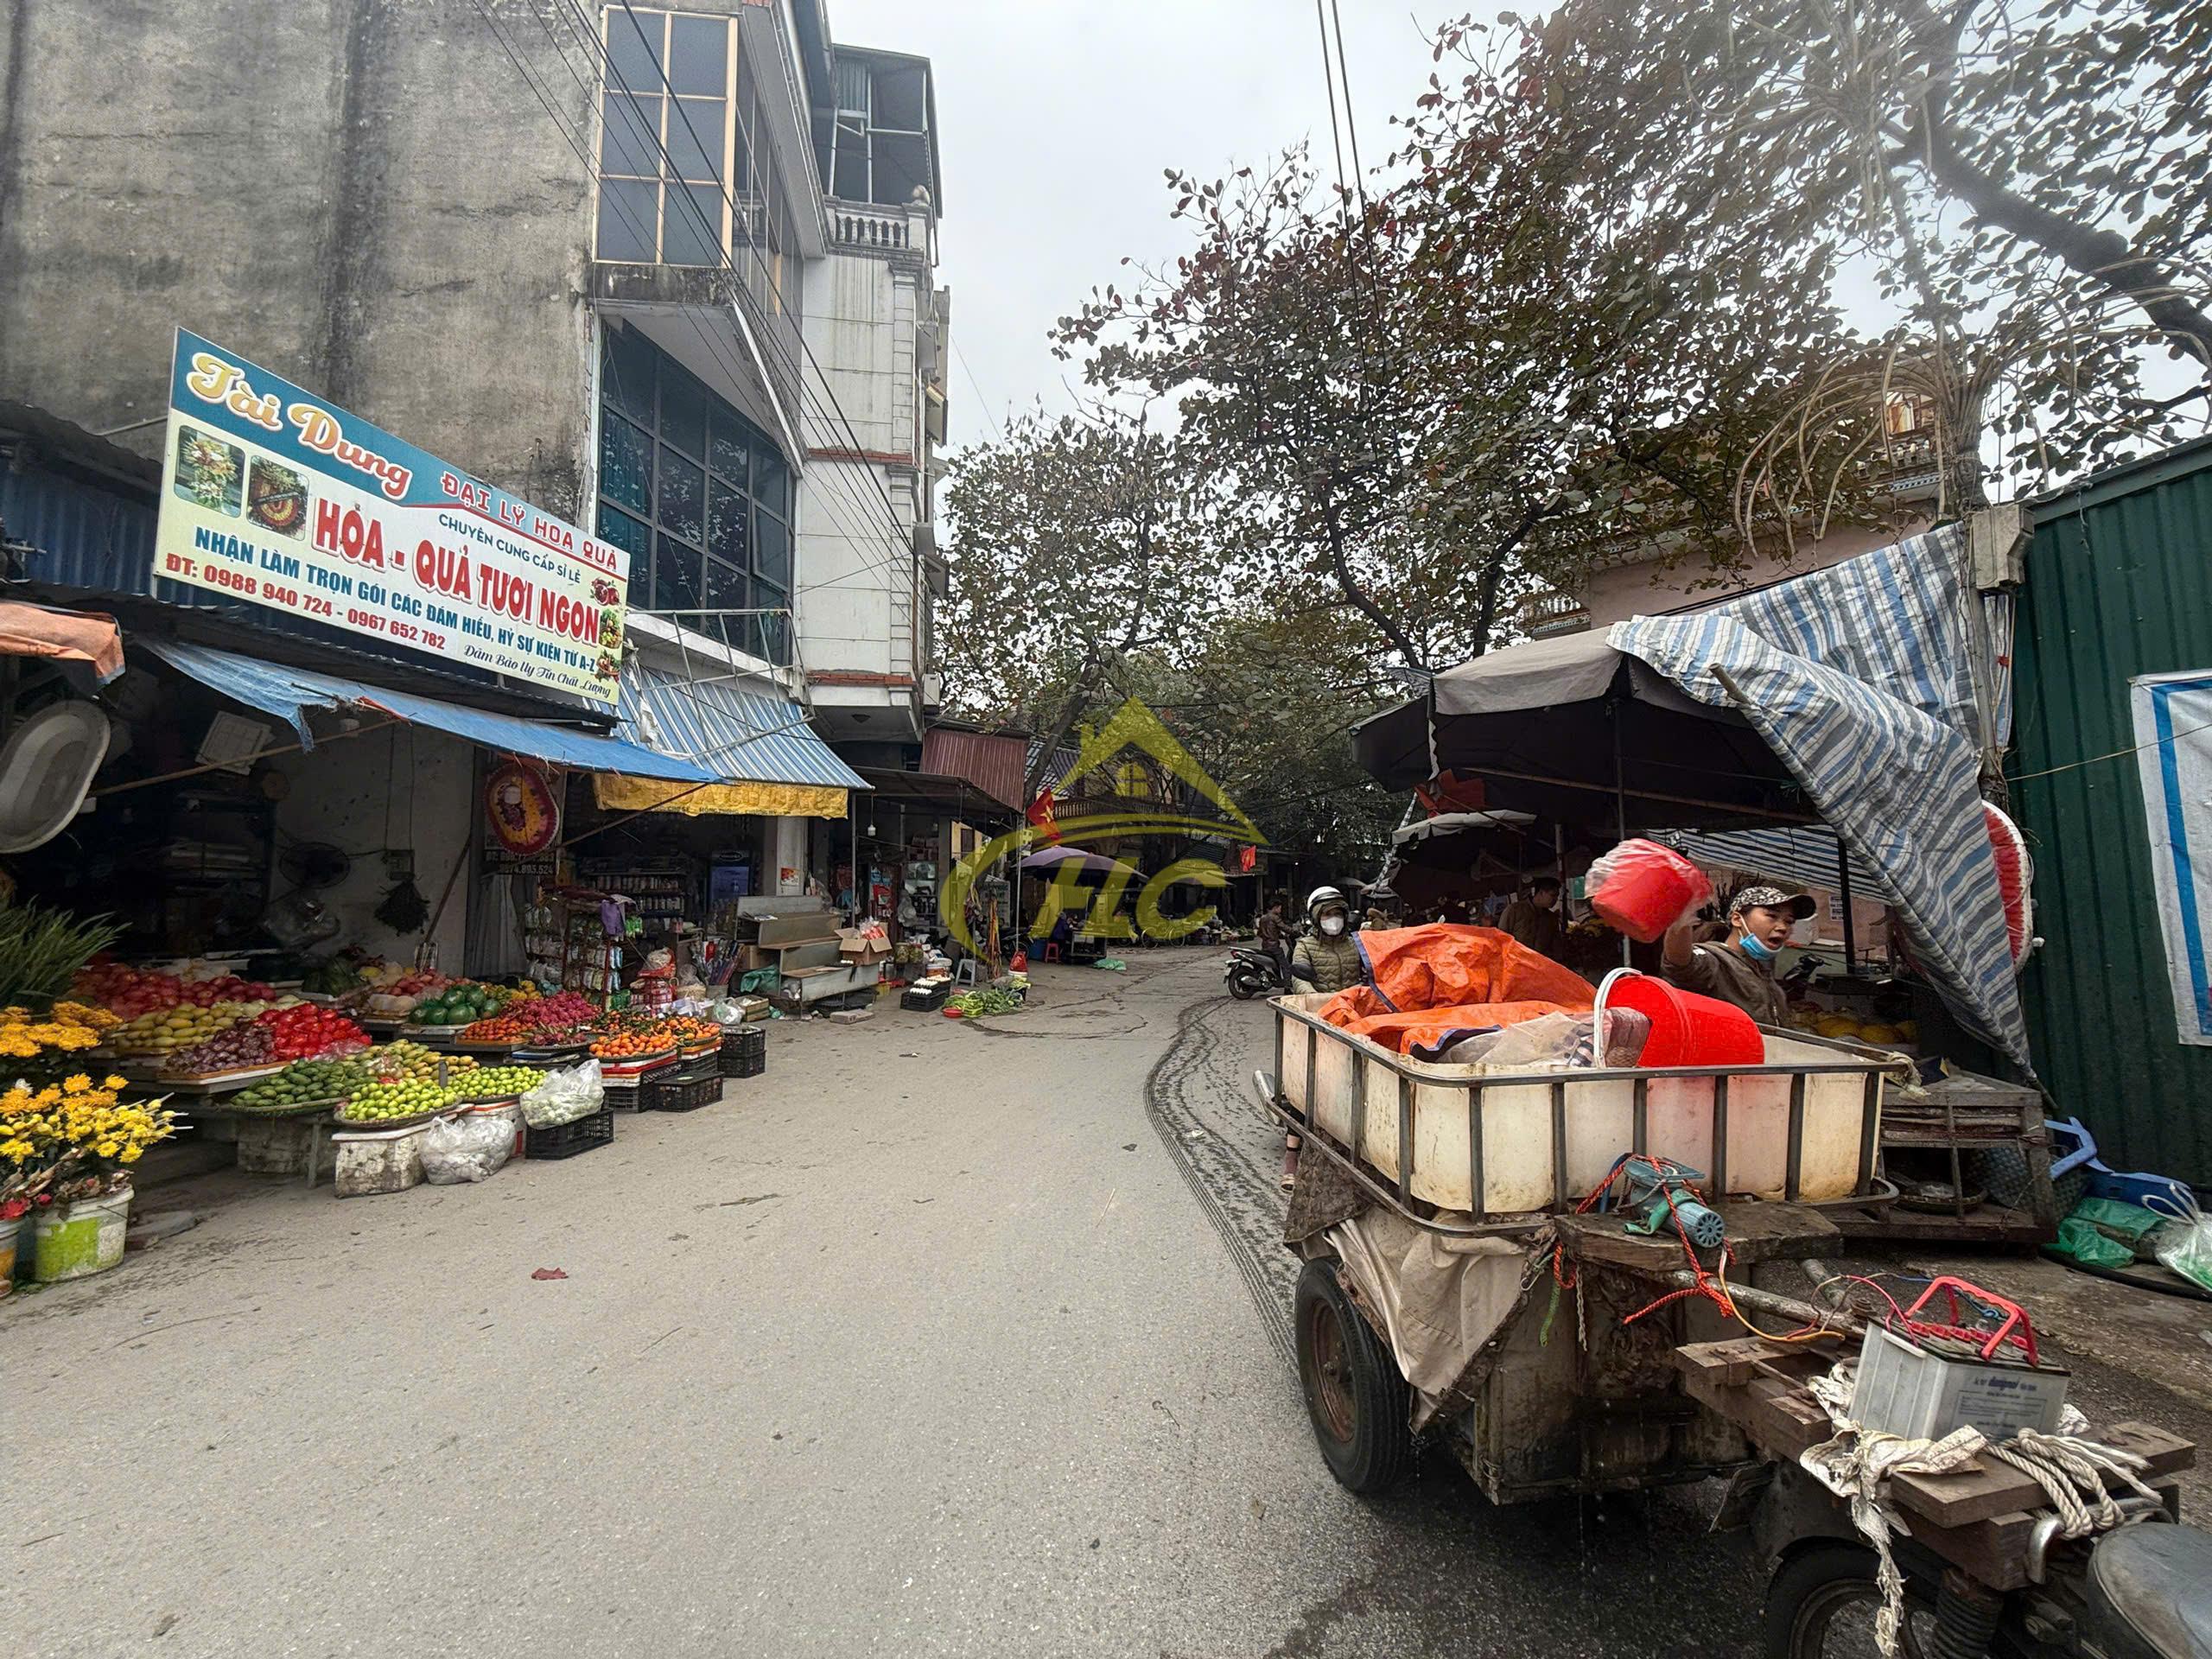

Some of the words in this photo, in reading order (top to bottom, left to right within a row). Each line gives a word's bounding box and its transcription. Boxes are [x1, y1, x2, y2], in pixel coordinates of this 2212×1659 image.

[187, 352, 283, 431] Tài
[287, 403, 413, 500] Dung
[439, 514, 493, 547] CHUYÊN
[496, 538, 530, 562] CUNG
[532, 553, 555, 571] CẤP
[442, 472, 491, 512] ĐẠI
[534, 517, 574, 550] HOA
[583, 540, 617, 570] QUẢ
[166, 552, 198, 577] ĐT:
[204, 564, 257, 594] 0988
[263, 582, 297, 607] 940
[302, 594, 333, 617] 724
[347, 608, 386, 632] 0967
[390, 620, 418, 641] 652
[422, 630, 446, 650] 782
[194, 526, 254, 565] NHẬN
[261, 548, 300, 580] LÀM
[307, 563, 353, 595] TRỌN
[358, 581, 386, 606] GÓI
[391, 592, 422, 617] CÁC
[427, 604, 458, 629] ĐÁM
[462, 615, 494, 643] HIẾU,
[518, 634, 534, 655] SỰ
[536, 641, 561, 662] KIỆN
[580, 655, 595, 672] A-Z
[314, 497, 385, 570] HOA
[415, 540, 473, 602] QUẢ
[480, 563, 534, 621] TƯƠI
[539, 588, 599, 645] NGON
[494, 652, 518, 670] Bảo
